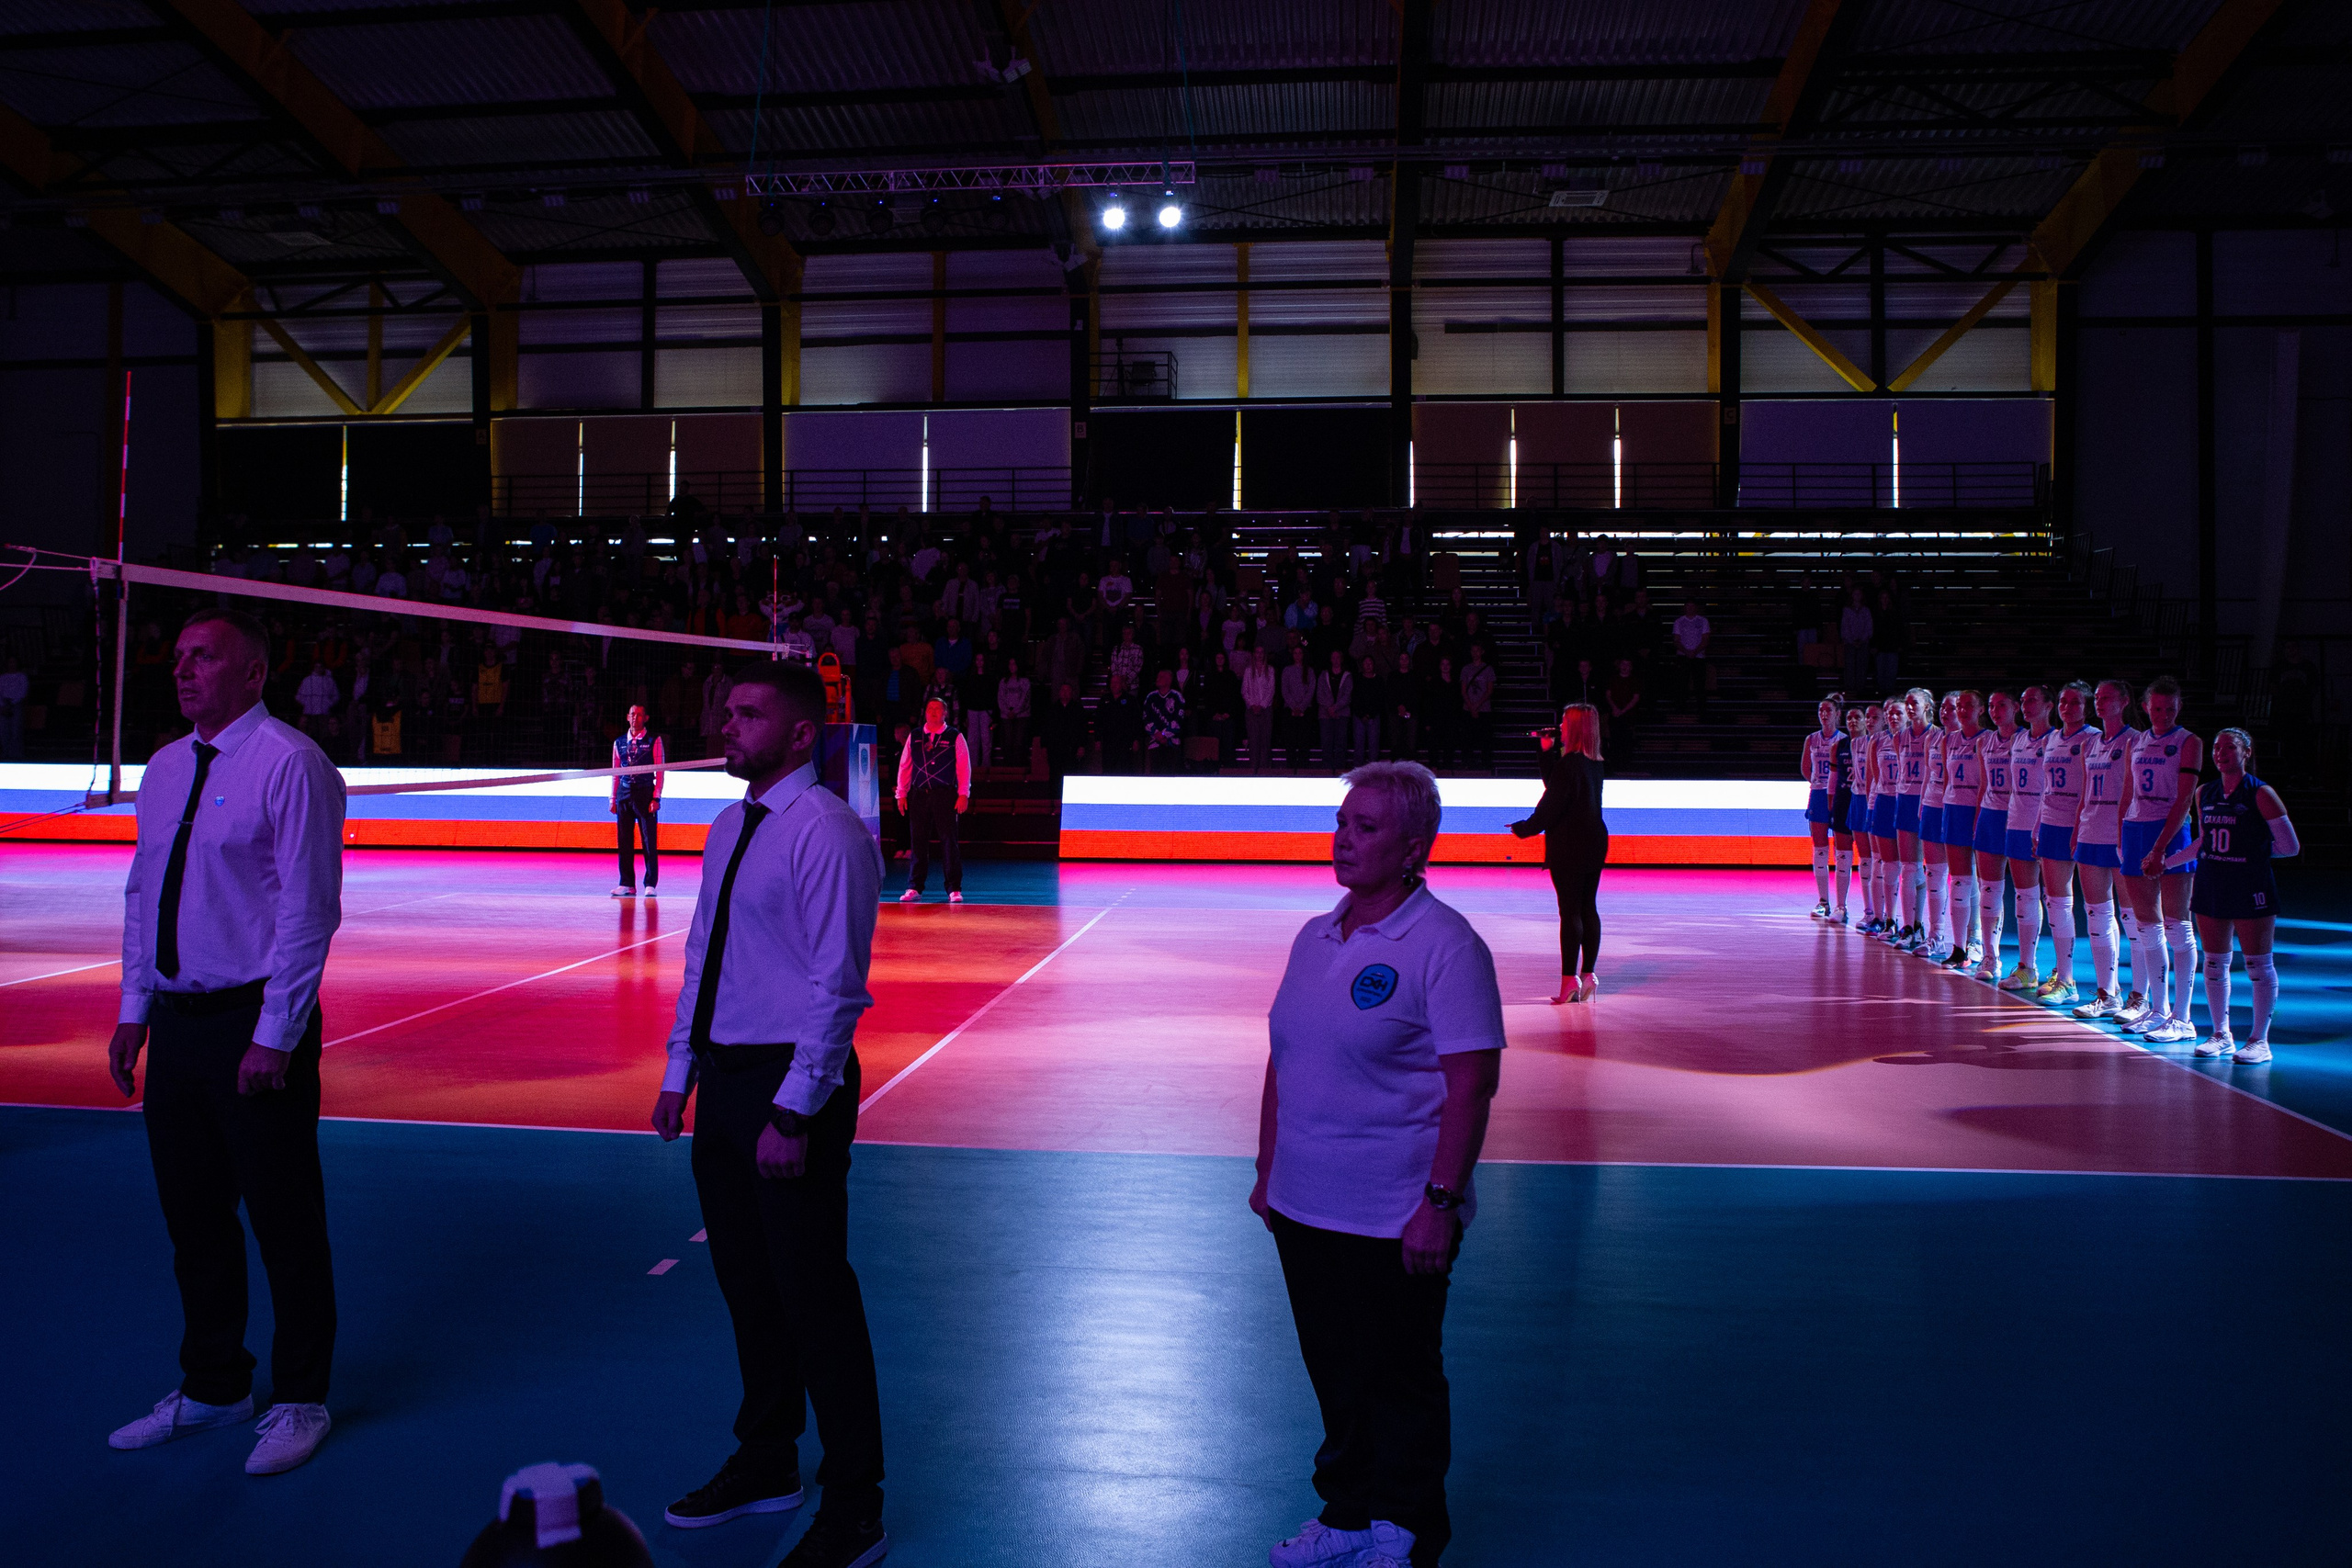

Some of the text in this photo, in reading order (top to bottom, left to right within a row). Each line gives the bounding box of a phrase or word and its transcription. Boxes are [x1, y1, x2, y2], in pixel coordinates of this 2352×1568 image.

[1817, 760, 1830, 774] 18
[1905, 761, 1919, 777] 14
[1936, 762, 1943, 778] 7
[2134, 757, 2166, 765] САХАЛИН
[1955, 763, 1964, 782] 4
[1990, 768, 2005, 787] 15
[2018, 768, 2028, 788] 8
[2049, 767, 2066, 788] 13
[2142, 768, 2154, 792] 3
[2093, 774, 2104, 796] 11
[2203, 815, 2237, 825] САХАЛИН
[2210, 828, 2231, 853] 10
[2252, 892, 2267, 906] 10
